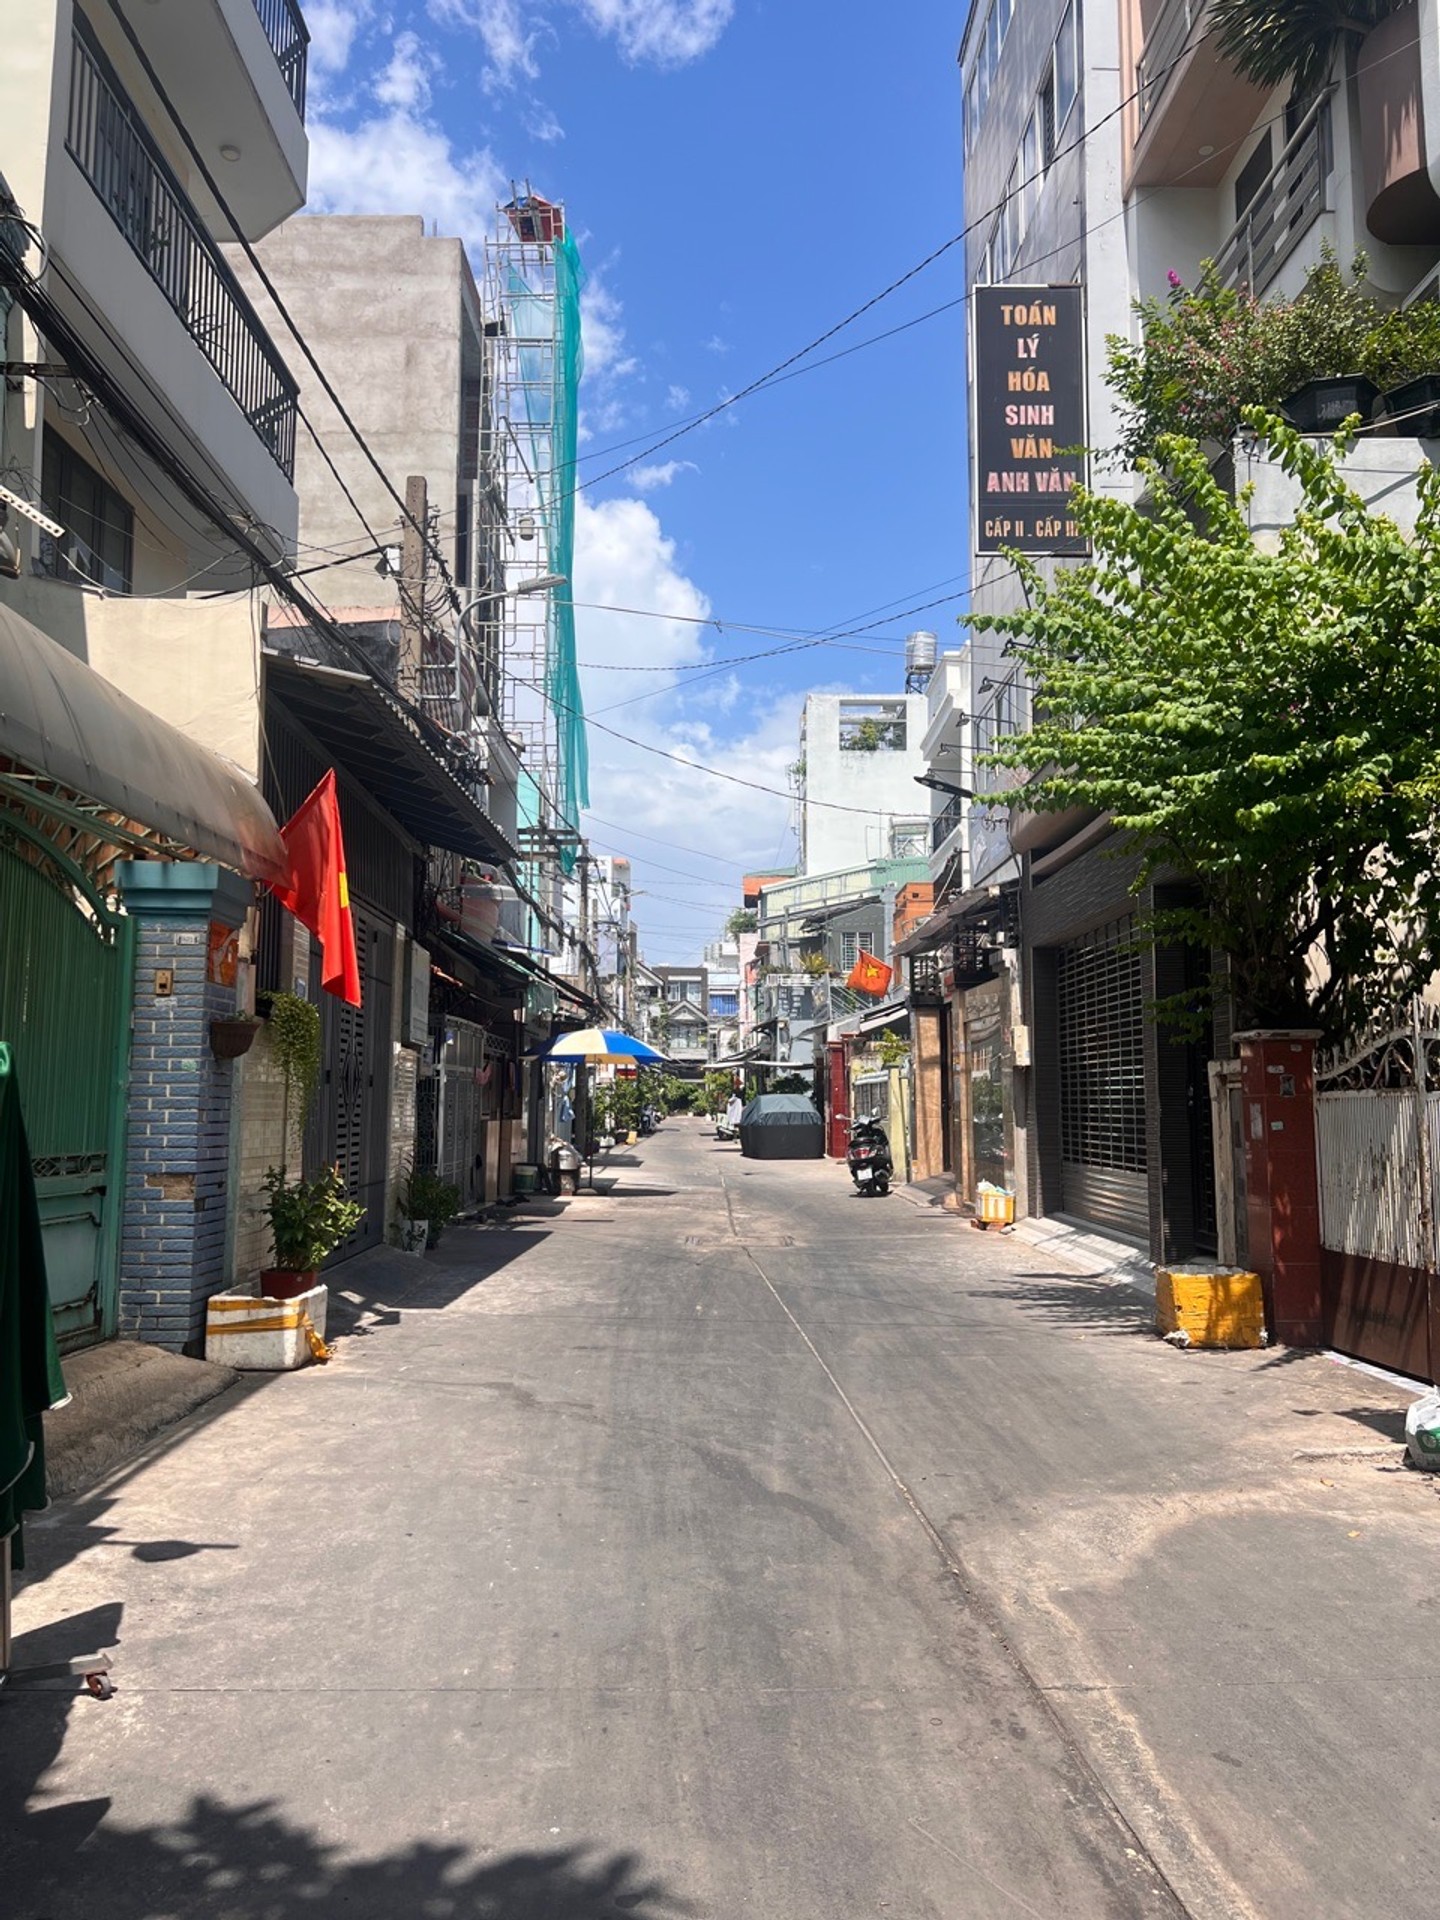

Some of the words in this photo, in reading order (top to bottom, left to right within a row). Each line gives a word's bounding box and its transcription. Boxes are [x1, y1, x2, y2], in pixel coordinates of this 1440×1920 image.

[1001, 301, 1057, 326] TOÁN
[1017, 333, 1040, 358] LÝ
[1007, 366, 1050, 392] HÓA
[1005, 405, 1054, 426] SINH
[1010, 434, 1053, 459] VĂN
[987, 471, 1029, 492] ANH
[1035, 467, 1076, 492] VĂN
[985, 515, 1011, 537] CẤP
[1015, 520, 1024, 537] II
[1036, 515, 1062, 537] CẤP
